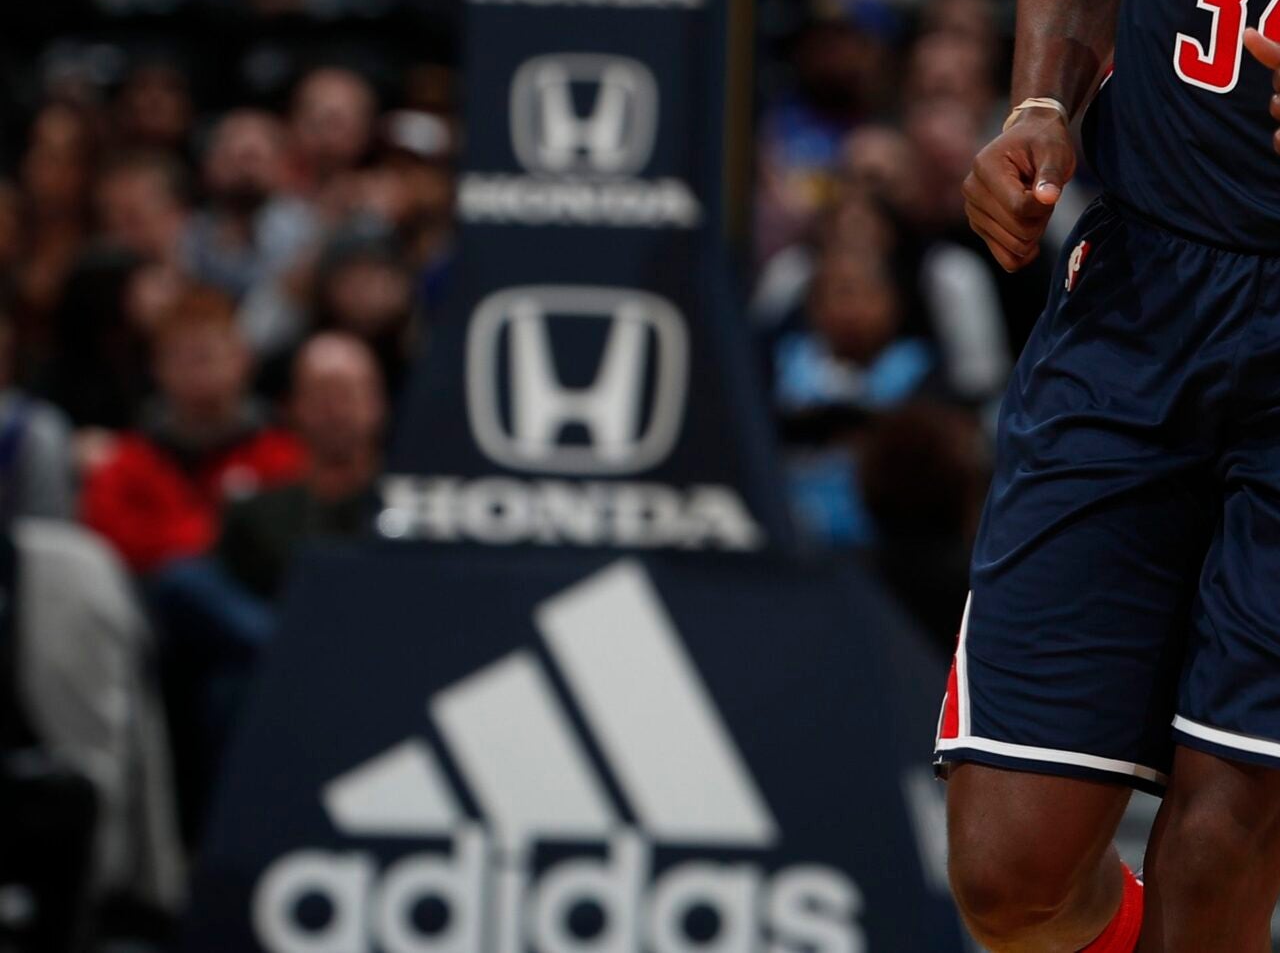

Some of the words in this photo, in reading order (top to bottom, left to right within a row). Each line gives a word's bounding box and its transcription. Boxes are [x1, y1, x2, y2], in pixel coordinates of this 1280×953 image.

[458, 173, 703, 228] HONDA
[377, 474, 764, 552] HONDA
[251, 822, 868, 953] adidas
